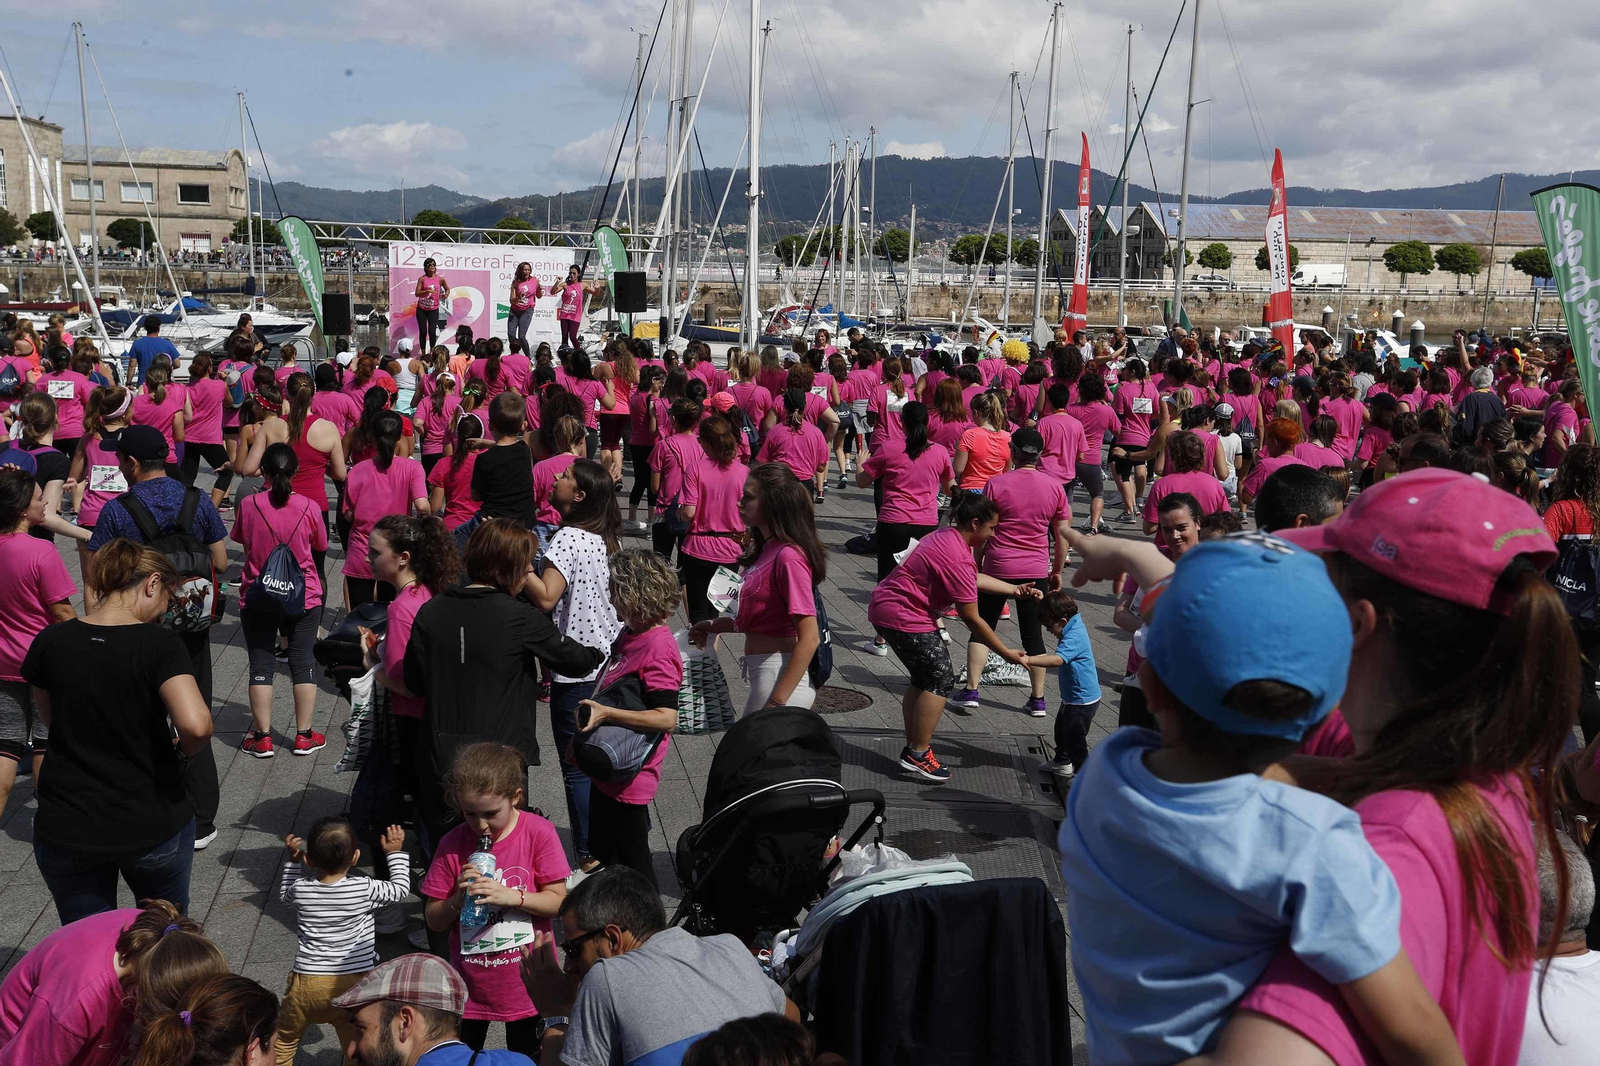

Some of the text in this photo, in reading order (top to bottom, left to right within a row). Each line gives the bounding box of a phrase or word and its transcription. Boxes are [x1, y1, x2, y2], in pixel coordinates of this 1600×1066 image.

[1371, 535, 1397, 560] Isa
[262, 574, 294, 591] ÚNICLA
[1555, 573, 1586, 591] NICLA
